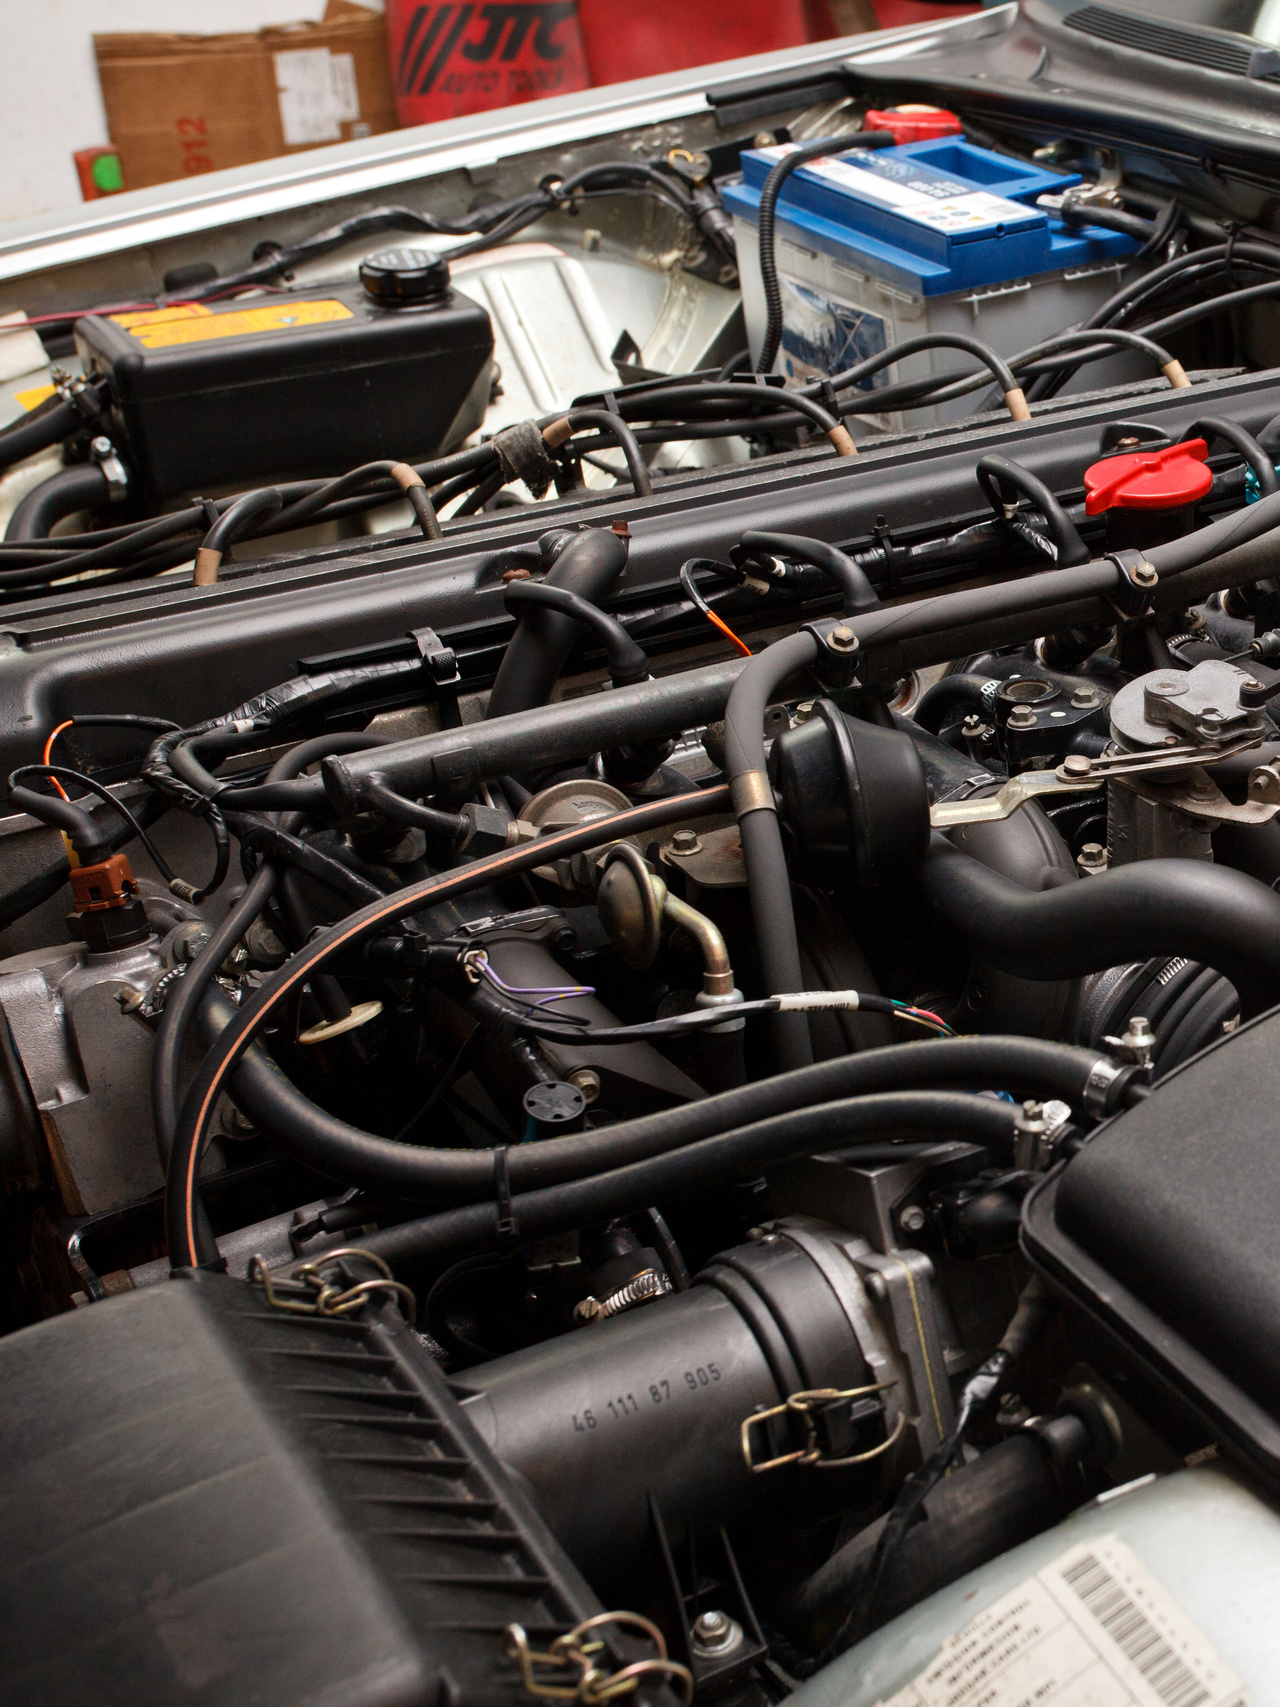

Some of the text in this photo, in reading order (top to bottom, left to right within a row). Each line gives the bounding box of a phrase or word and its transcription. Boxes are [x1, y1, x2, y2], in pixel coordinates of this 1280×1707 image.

[459, 3, 577, 64] JTC
[571, 1362, 722, 1433] 46 111 87 905
